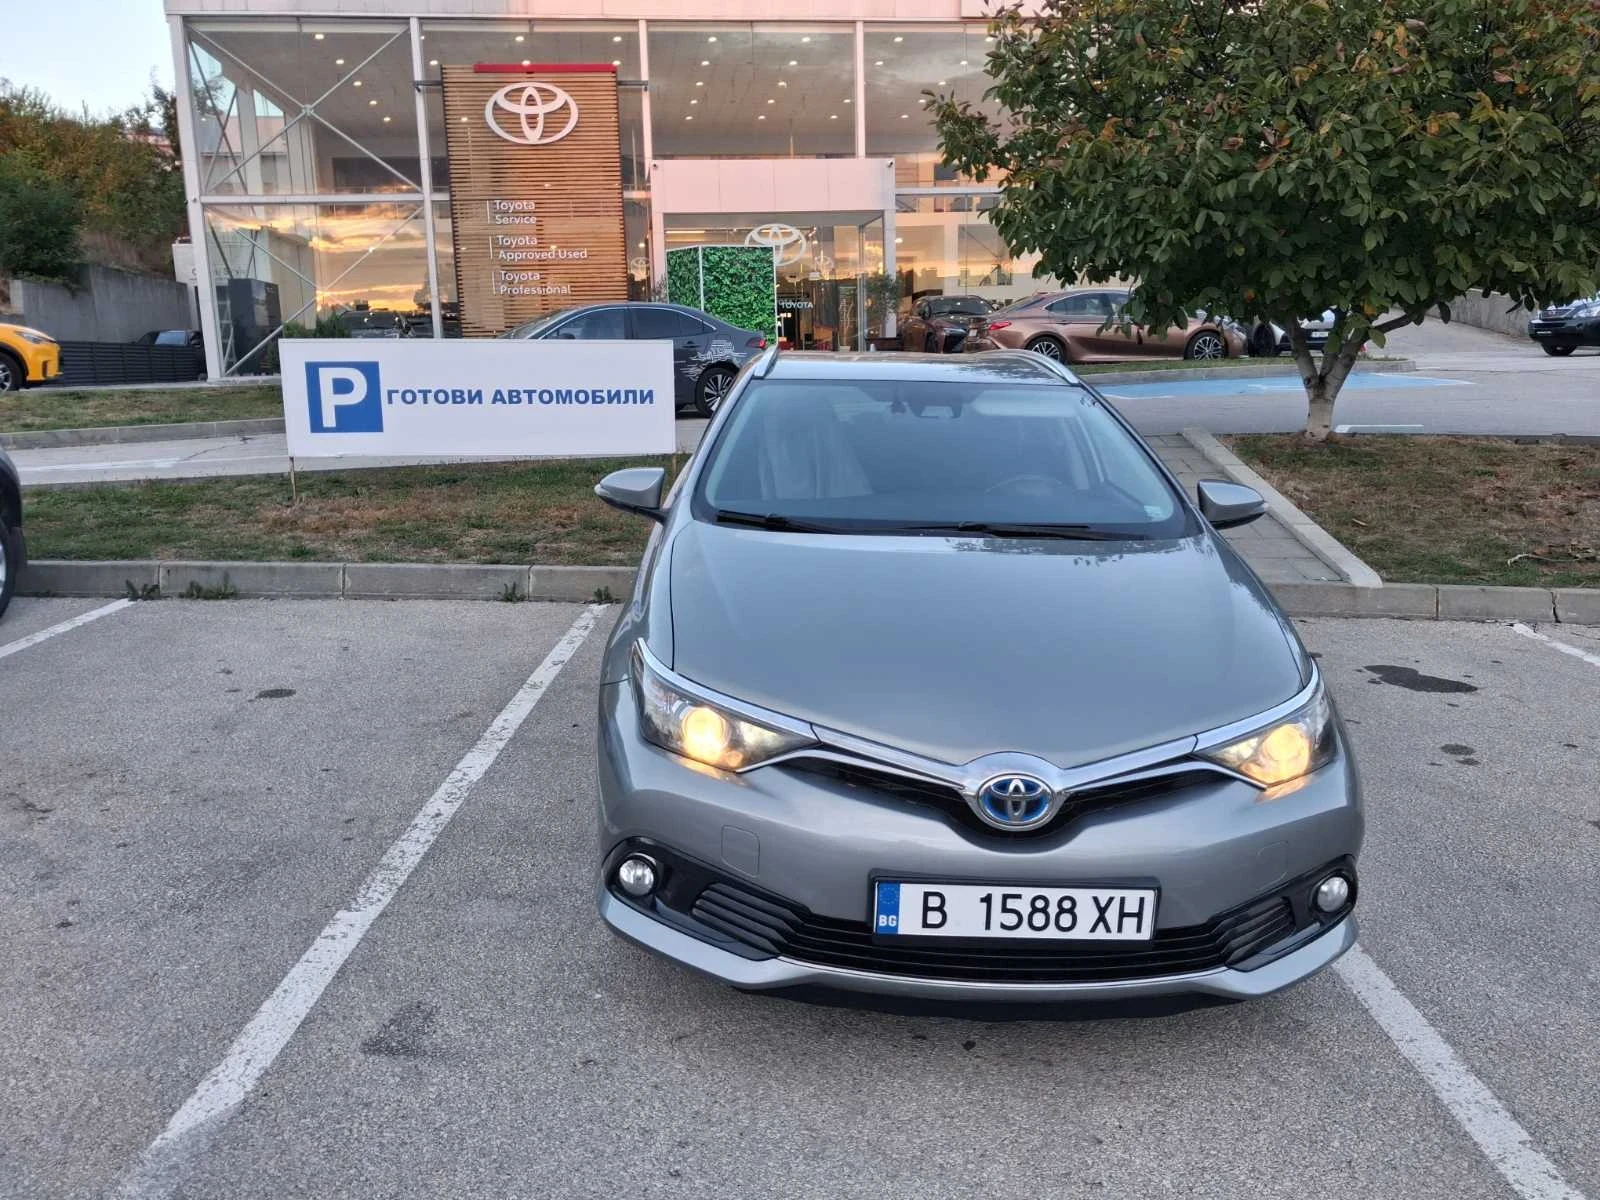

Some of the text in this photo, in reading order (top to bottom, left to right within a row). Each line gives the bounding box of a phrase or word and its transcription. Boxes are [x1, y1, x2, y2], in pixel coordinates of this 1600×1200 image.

[494, 200, 535, 212] Toyota
[495, 215, 537, 225] Service
[496, 235, 538, 248] Toyota
[499, 248, 588, 261] Approved Used
[500, 271, 540, 283] Toyota
[500, 284, 571, 295] Professional
[781, 301, 814, 309] TOYOTA
[318, 367, 654, 428] P ГОТОВИ АВТОМОБИЛИ
[921, 891, 1145, 934] B 1588 XH
[878, 914, 897, 927] BG
